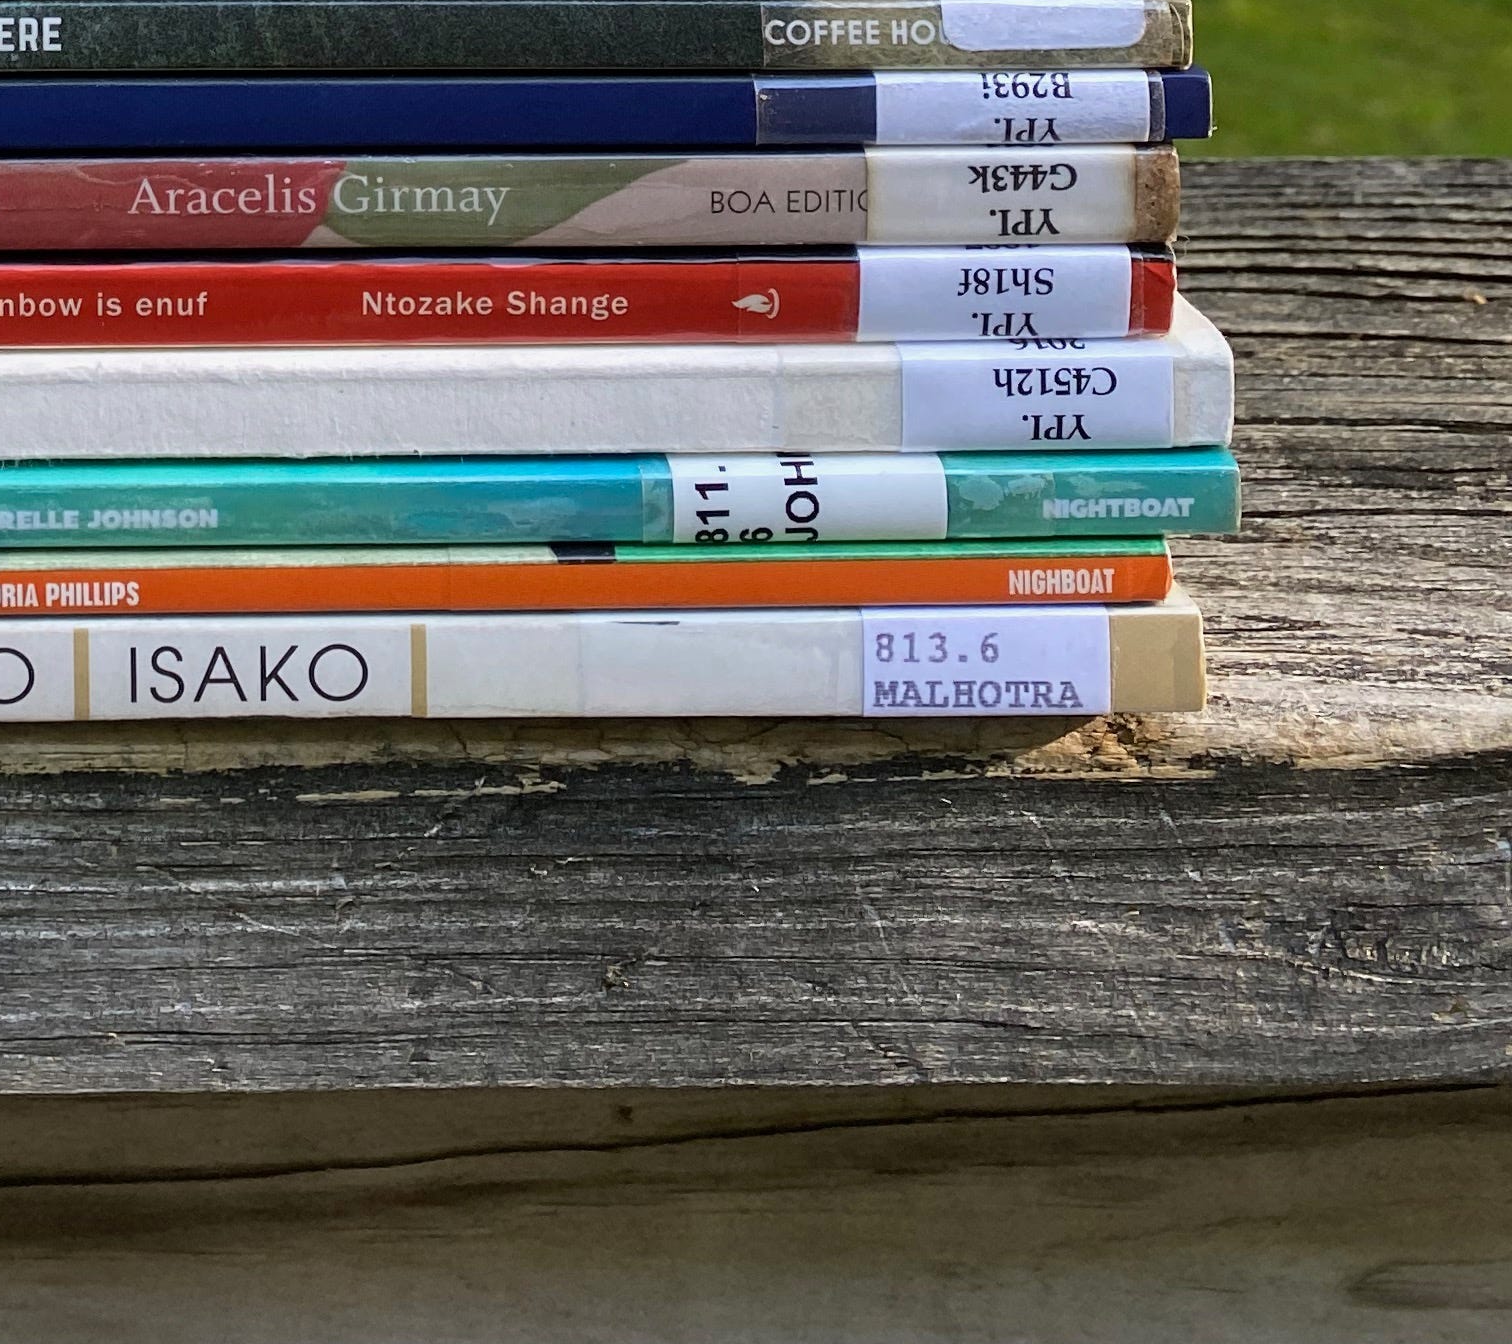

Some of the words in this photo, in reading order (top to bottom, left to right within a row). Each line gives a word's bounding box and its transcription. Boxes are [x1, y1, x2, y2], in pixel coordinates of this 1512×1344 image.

[764, 20, 880, 45] COFFEE
[968, 164, 1077, 193] G443k
[128, 175, 316, 219] Aracelis
[334, 172, 511, 226] Girmay
[711, 191, 775, 213] BOA
[957, 268, 1054, 296] Sh18f
[96, 291, 122, 317] is
[135, 291, 207, 317] enuf
[362, 291, 498, 316] Ntozake
[506, 291, 629, 320] Shange
[994, 367, 1117, 396] C4512h
[88, 509, 217, 529] JOHNSON
[1043, 498, 1193, 519] NIGHTBOAT
[46, 581, 139, 606] PHILLIPS
[1008, 568, 1114, 594] NIGHBOAT
[875, 633, 998, 663] 813.6
[130, 643, 369, 703] ISAKO
[873, 681, 1082, 709] MALHOTRA
